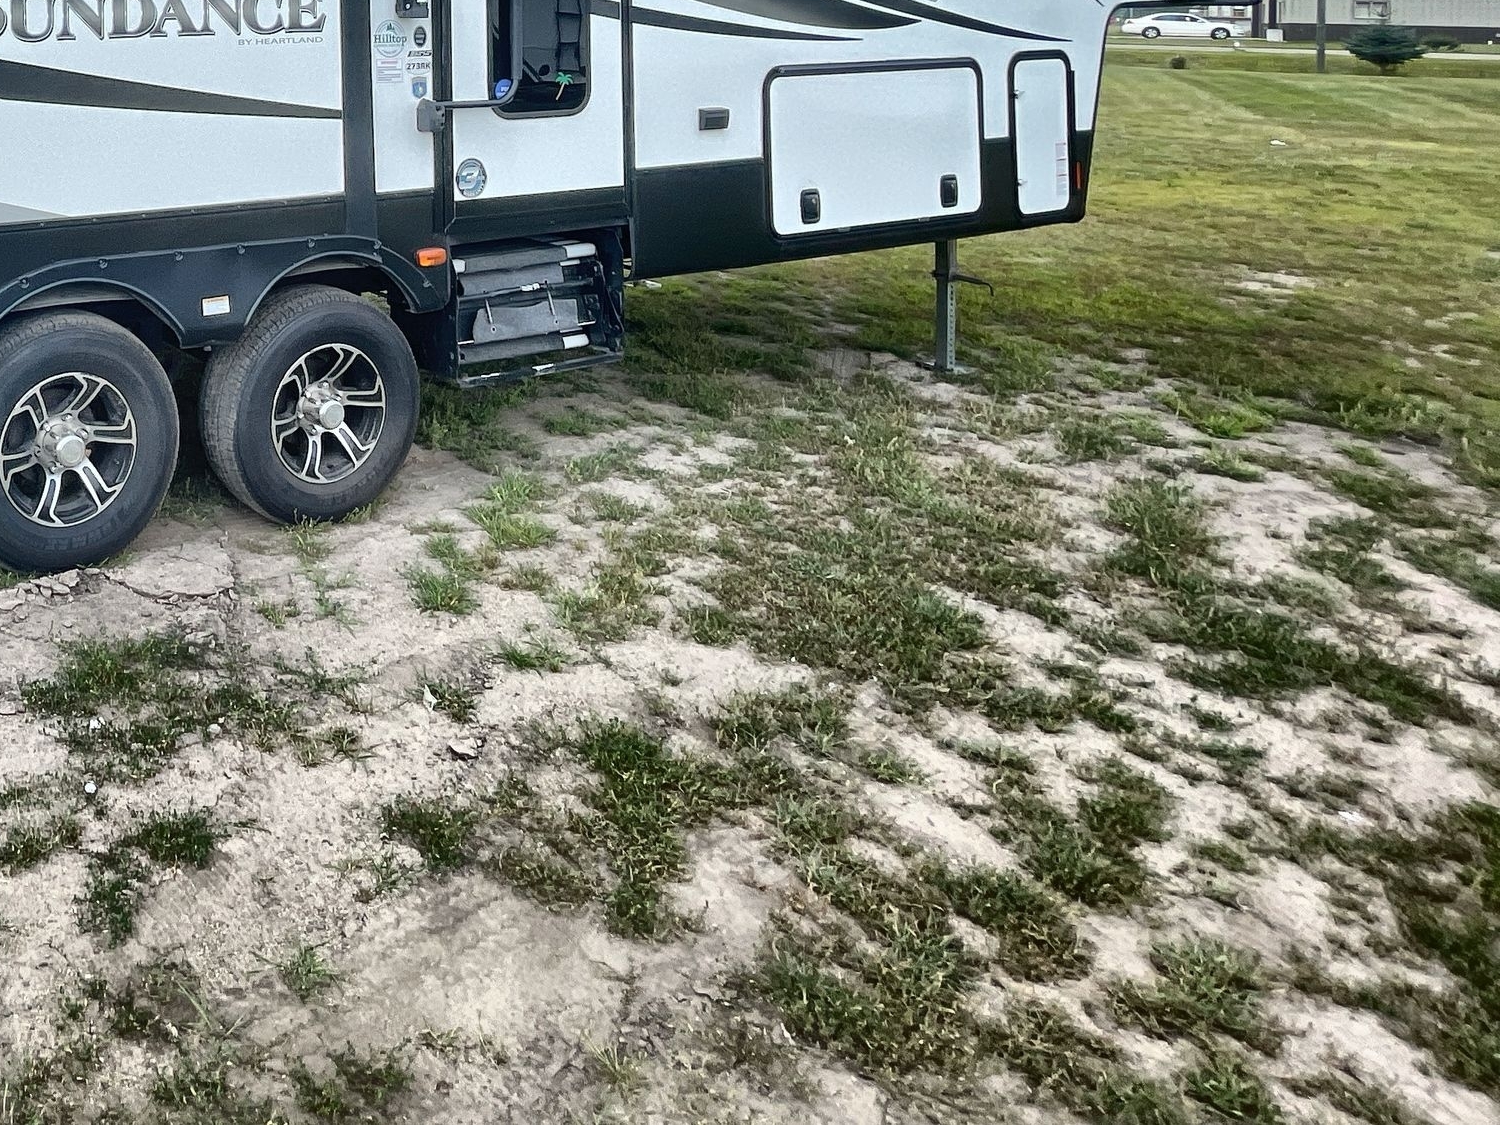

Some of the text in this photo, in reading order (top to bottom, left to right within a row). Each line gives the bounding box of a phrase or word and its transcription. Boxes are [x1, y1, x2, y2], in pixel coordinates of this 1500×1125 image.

[238, 36, 324, 46] BY HEARTLAND
[373, 34, 407, 46] Hilltop
